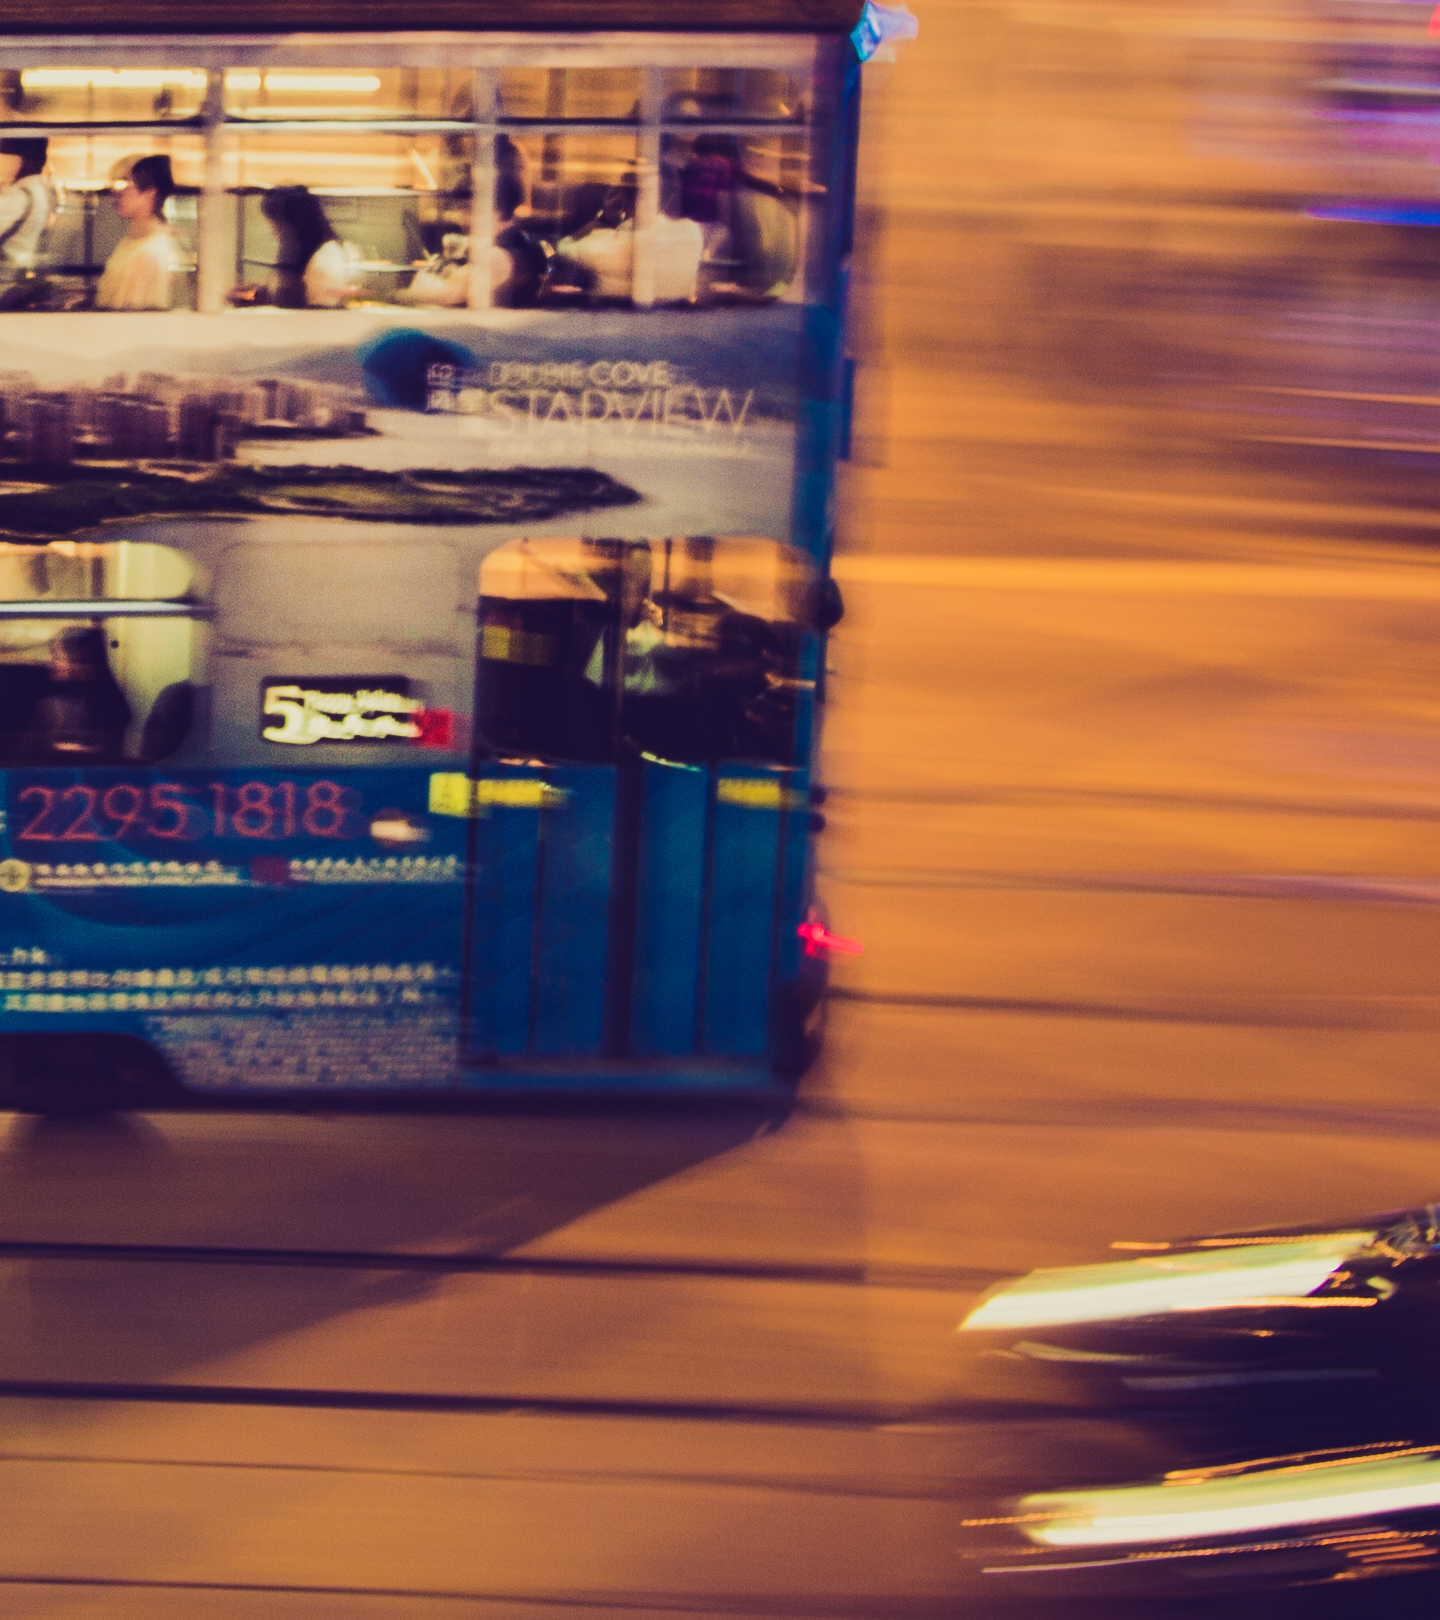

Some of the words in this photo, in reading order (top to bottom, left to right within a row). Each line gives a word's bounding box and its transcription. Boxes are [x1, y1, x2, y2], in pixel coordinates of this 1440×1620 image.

[589, 359, 672, 386] COVE
[262, 685, 308, 745] 5
[19, 784, 190, 840] 2295
[209, 780, 346, 837] 1818
